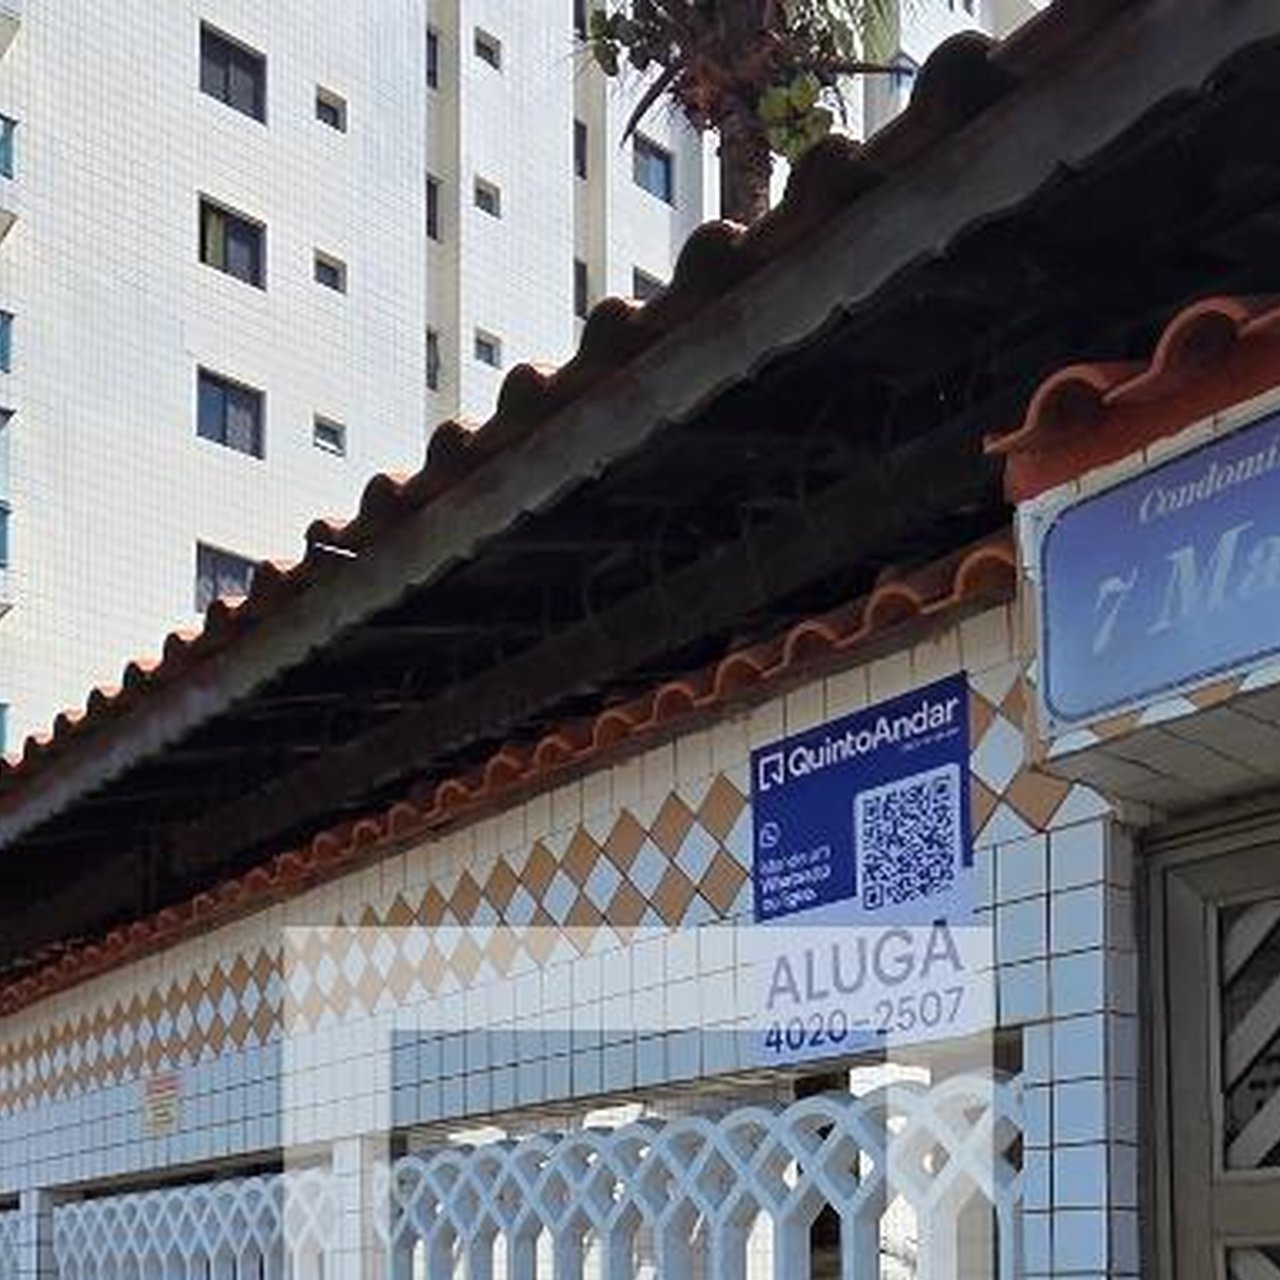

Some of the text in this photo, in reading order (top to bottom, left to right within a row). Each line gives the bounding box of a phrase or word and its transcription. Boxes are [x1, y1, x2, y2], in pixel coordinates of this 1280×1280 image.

[1092, 563, 1139, 656] 7
[787, 697, 959, 777] QuintoAndar
[766, 918, 965, 1010] ALUGA
[765, 986, 965, 1054] 4020-2507
